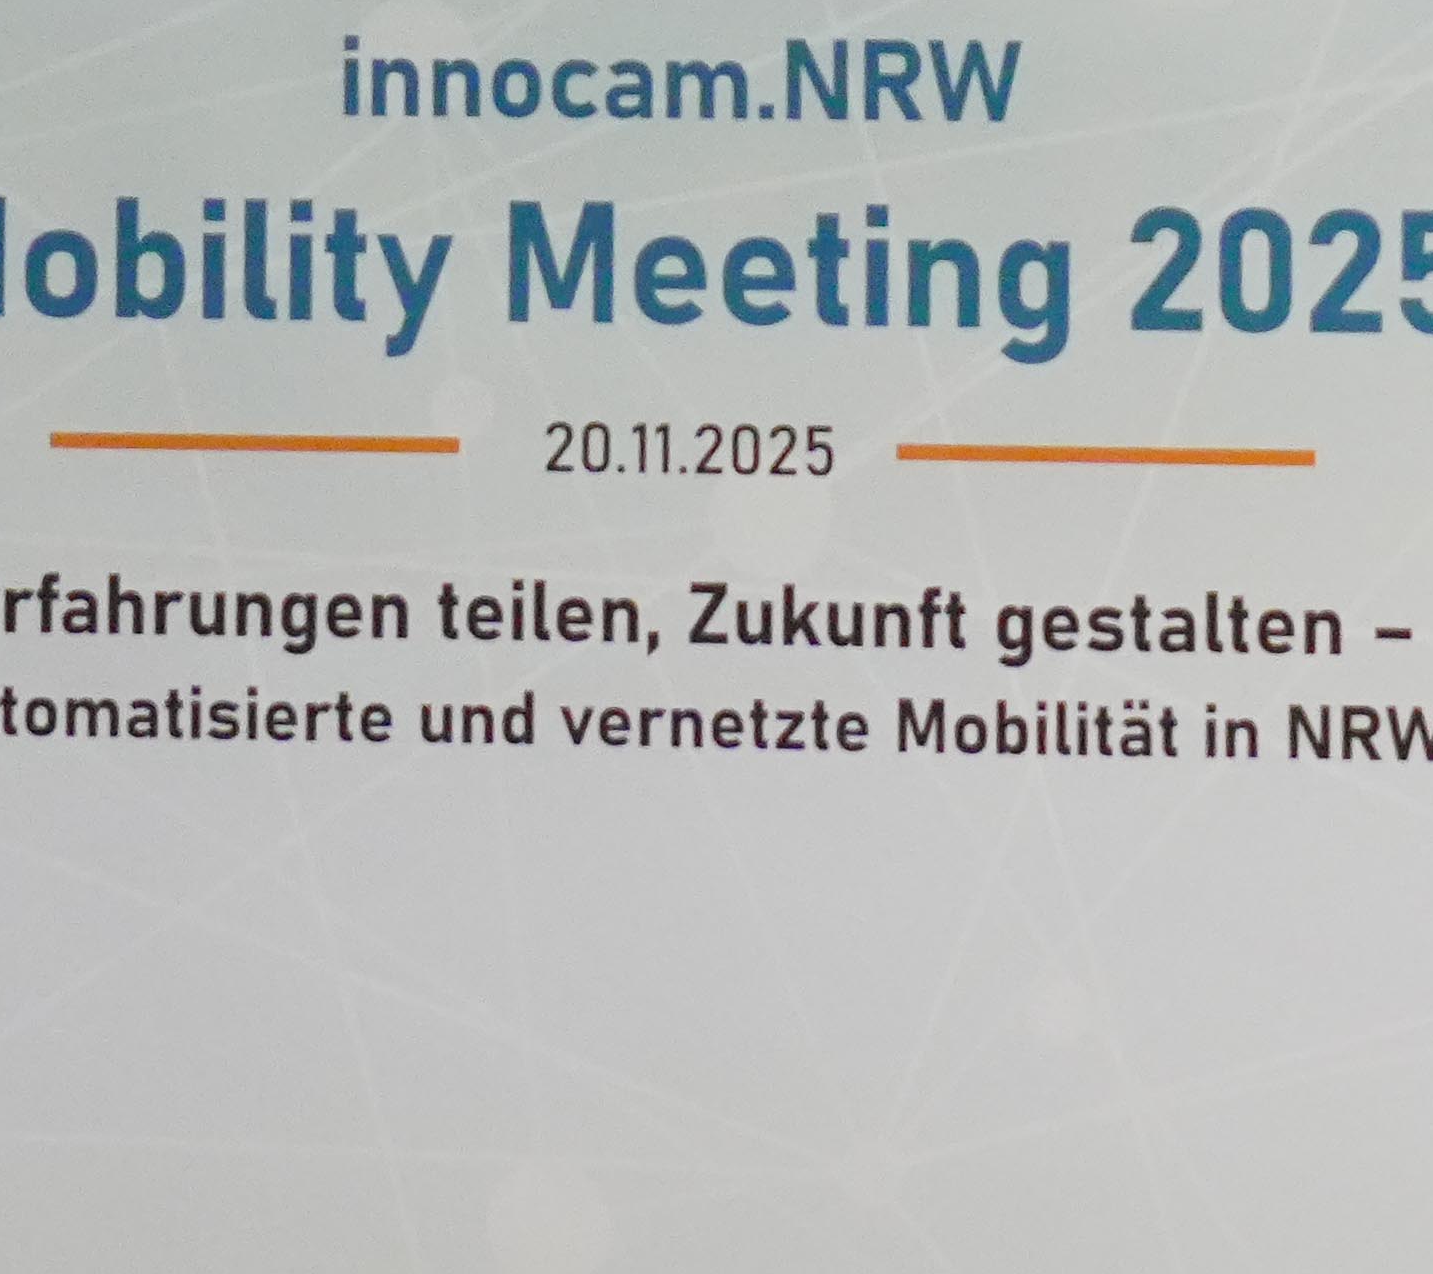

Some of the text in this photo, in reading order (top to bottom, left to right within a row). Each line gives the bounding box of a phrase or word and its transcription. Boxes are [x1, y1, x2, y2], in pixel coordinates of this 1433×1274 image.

[344, 36, 1020, 122] innocam.NRW
[509, 201, 1070, 364] Meeting
[545, 421, 834, 477] 20.11.2025
[438, 580, 659, 653] teilen,
[689, 583, 966, 649] Zukunft
[997, 592, 1341, 668] gestalten
[420, 691, 534, 745] und
[561, 700, 869, 752] vernetzte
[898, 699, 1178, 758] Mobilität
[1205, 704, 1258, 759] in
